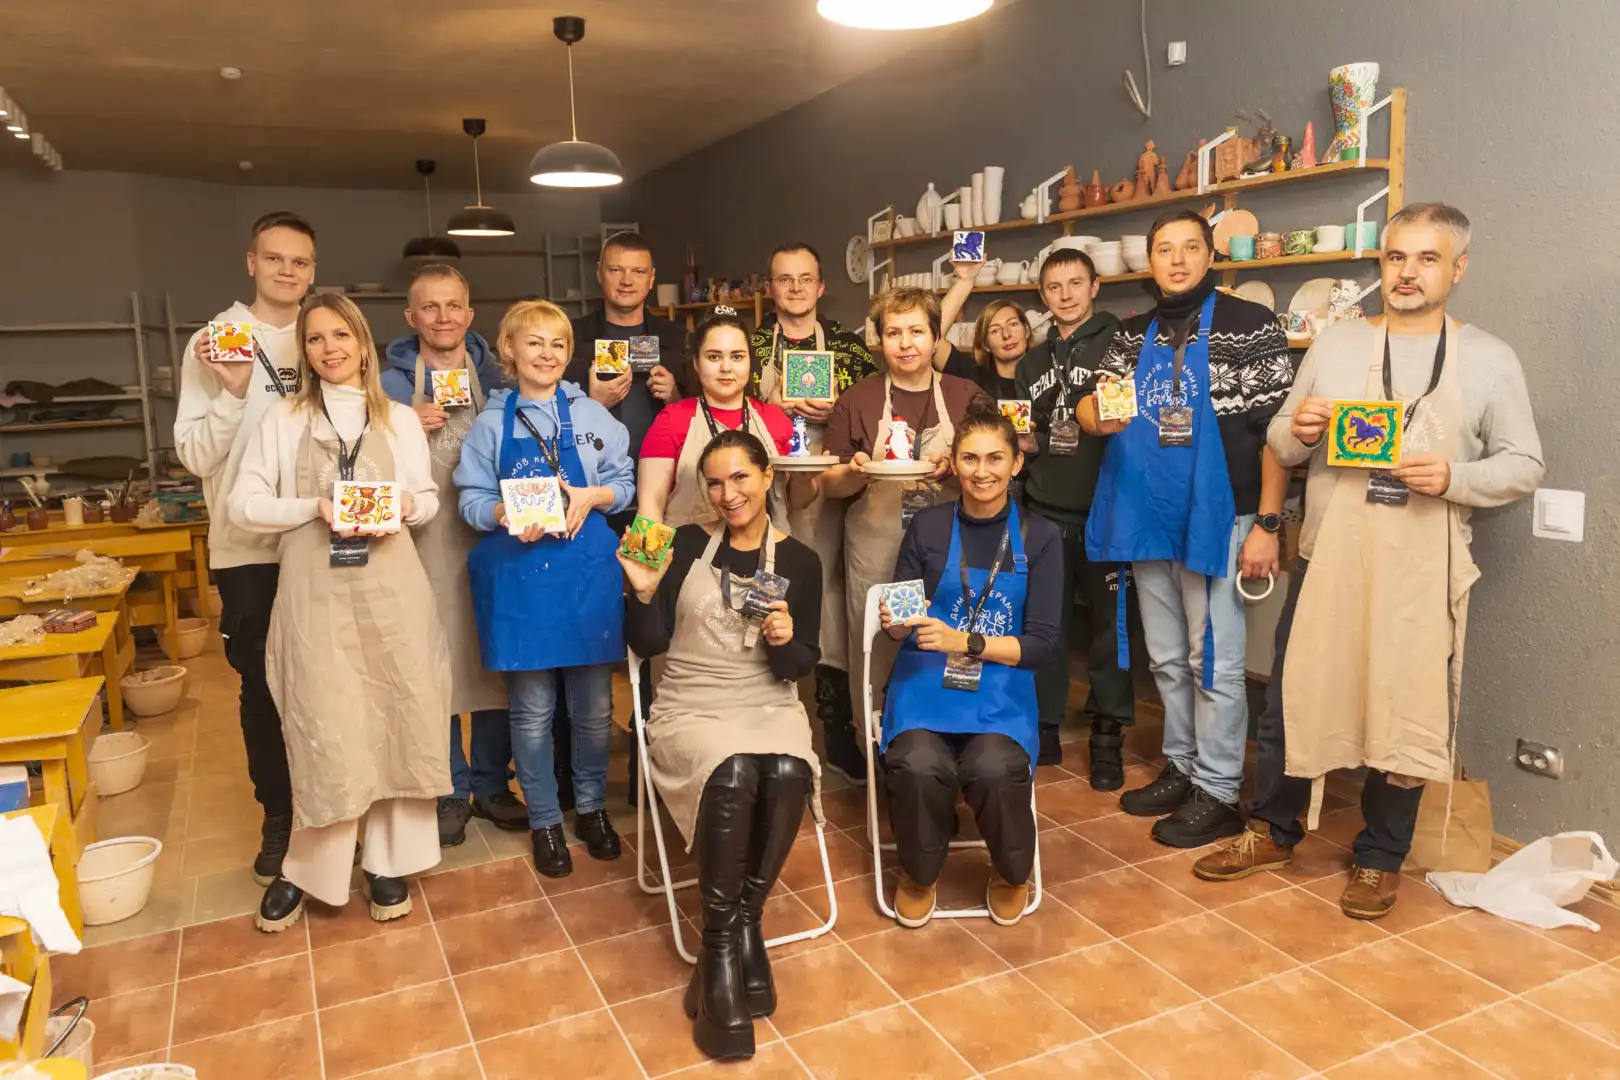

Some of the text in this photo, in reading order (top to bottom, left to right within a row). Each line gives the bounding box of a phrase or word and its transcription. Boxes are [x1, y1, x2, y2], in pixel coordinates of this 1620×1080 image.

[1167, 361, 1199, 398] КАМИКА
[950, 588, 1013, 632] ДЫМВ ЕРАМИКА
